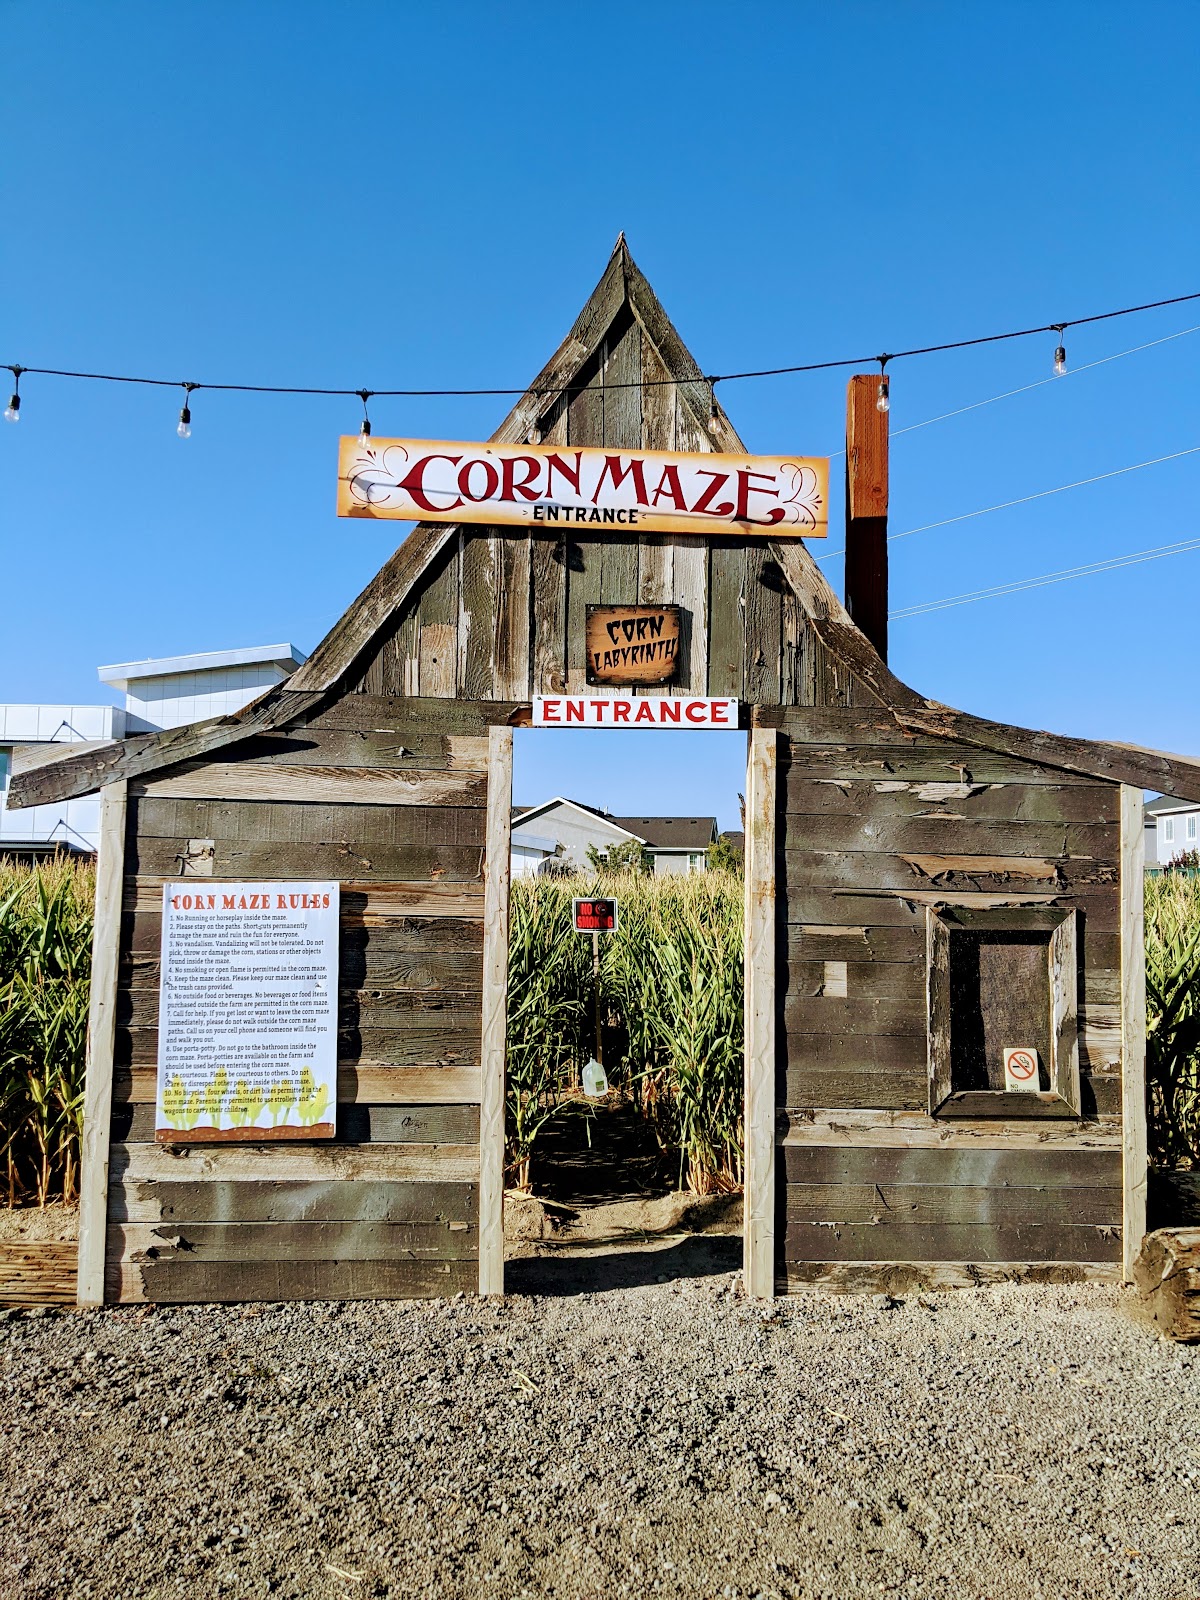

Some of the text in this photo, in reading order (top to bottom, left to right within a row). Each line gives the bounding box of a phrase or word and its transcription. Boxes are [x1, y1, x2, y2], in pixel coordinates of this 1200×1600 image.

[397, 451, 786, 525] CORN MAZE
[533, 505, 639, 524] ENTRANCE
[606, 615, 664, 645] CORN
[594, 637, 678, 671] LABYRINTH
[543, 700, 729, 722] ENTRANCE
[172, 893, 331, 910] CORN MAZE RULES
[580, 903, 593, 916] NO
[185, 914, 208, 922] Running
[217, 914, 243, 922] horseplay
[194, 923, 206, 931] stay
[273, 922, 307, 930] permanently
[170, 932, 191, 940] damage
[216, 940, 248, 948] Vandalizing
[302, 948, 321, 956] objects
[184, 966, 207, 974] smoking
[253, 966, 280, 974] permitted
[174, 975, 188, 983] Keep
[251, 974, 263, 982] keep
[264, 991, 291, 999] beverages
[168, 1001, 196, 1009] purchased
[254, 1000, 282, 1008] permitted
[227, 1009, 235, 1017] get
[206, 1018, 223, 1026] please
[239, 1026, 255, 1034] phone
[197, 1053, 233, 1062] Porta-potties
[226, 1062, 250, 1070] entering
[188, 1080, 216, 1088] disrespect
[234, 1079, 252, 1087] people
[277, 1086, 305, 1095] permitted
[229, 1097, 256, 1105] permitted
